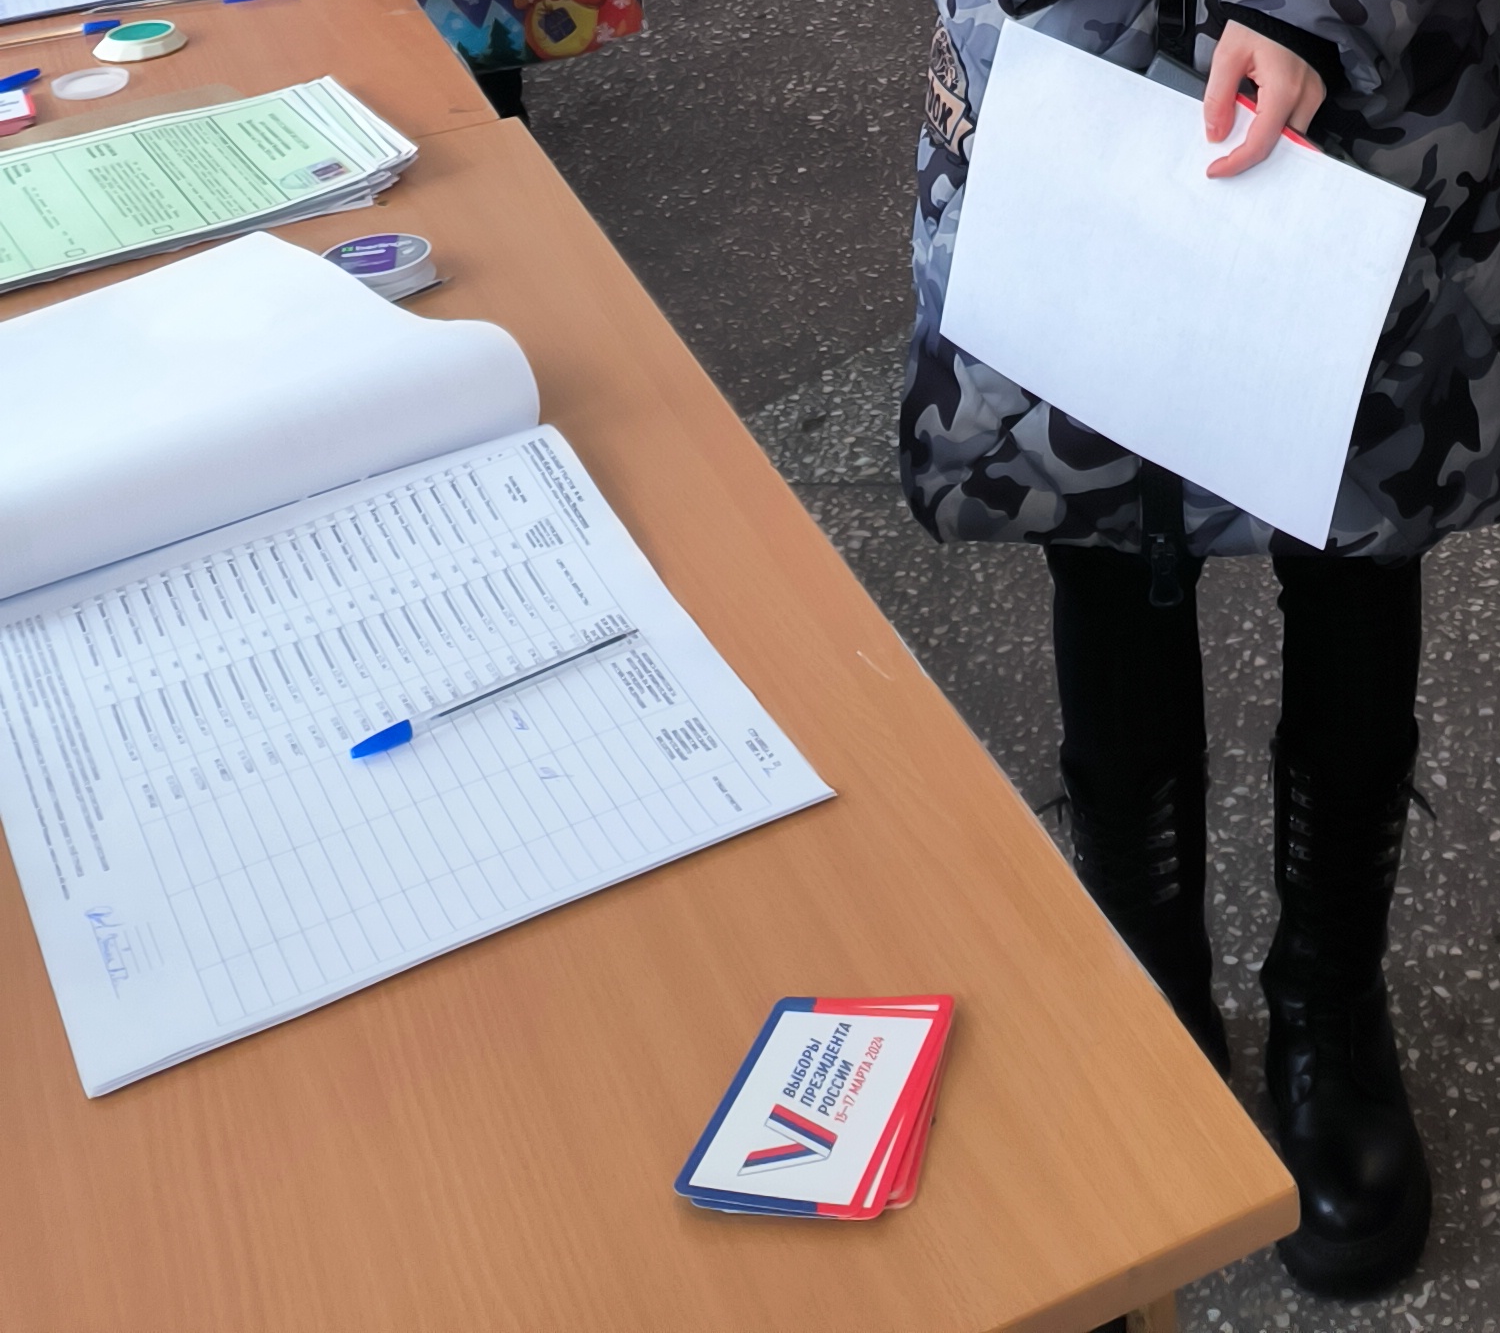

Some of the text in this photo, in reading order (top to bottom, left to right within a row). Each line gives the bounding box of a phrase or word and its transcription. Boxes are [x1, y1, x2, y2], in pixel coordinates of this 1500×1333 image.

[782, 1038, 823, 1099] ВЫБОРЫ
[799, 1021, 852, 1108] ПРЕЗИДЕНТА
[817, 1059, 854, 1117] РОССИИ
[850, 1062, 873, 1095] МАРТА
[866, 1036, 884, 1062] 2024
